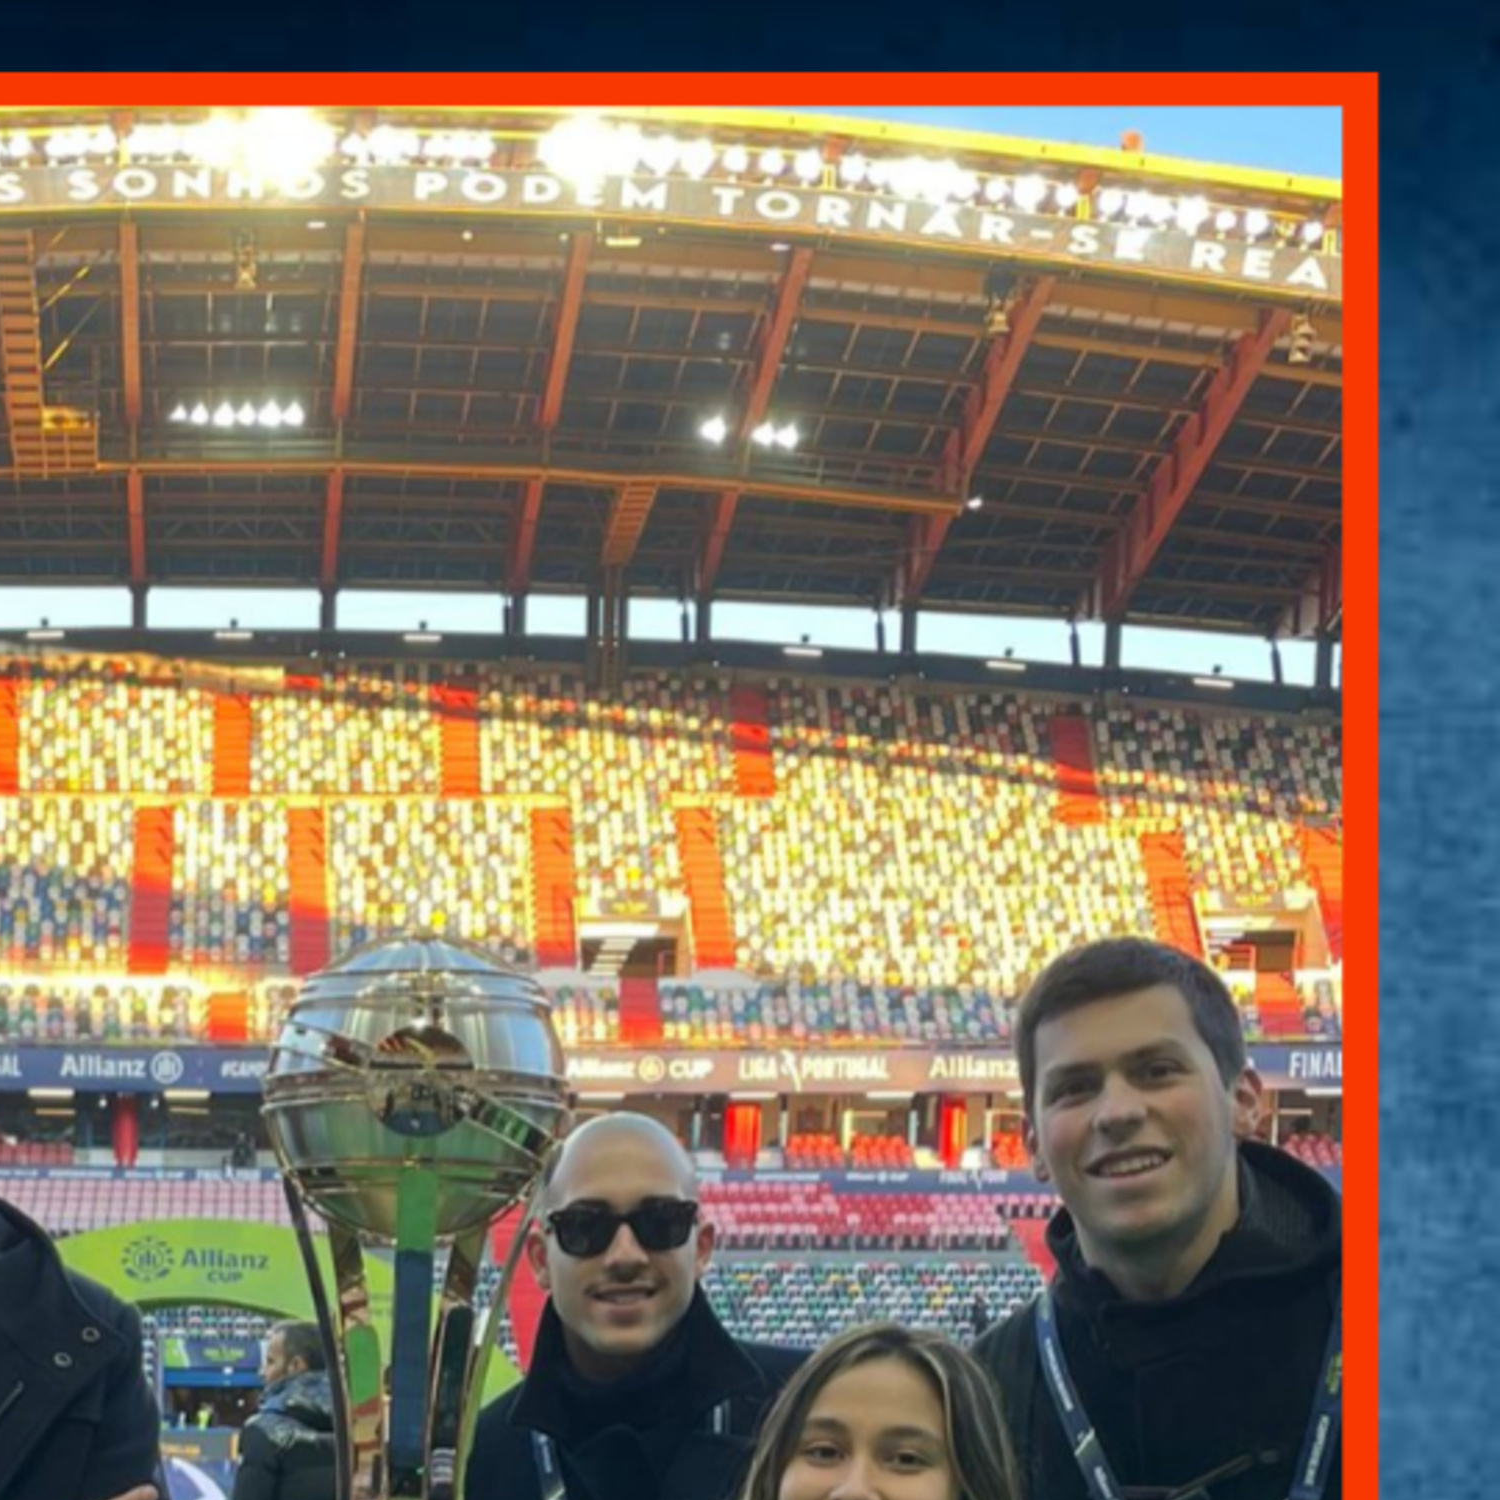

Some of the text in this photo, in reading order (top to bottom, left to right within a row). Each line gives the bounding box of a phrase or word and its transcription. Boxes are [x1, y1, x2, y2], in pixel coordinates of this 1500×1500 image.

[60, 1054, 146, 1079] Allianz
[668, 1058, 714, 1079] CUP
[739, 1056, 890, 1080] LIGA PORTUGAL
[181, 1248, 270, 1270] Allianz
[207, 1271, 243, 1284] CUP
